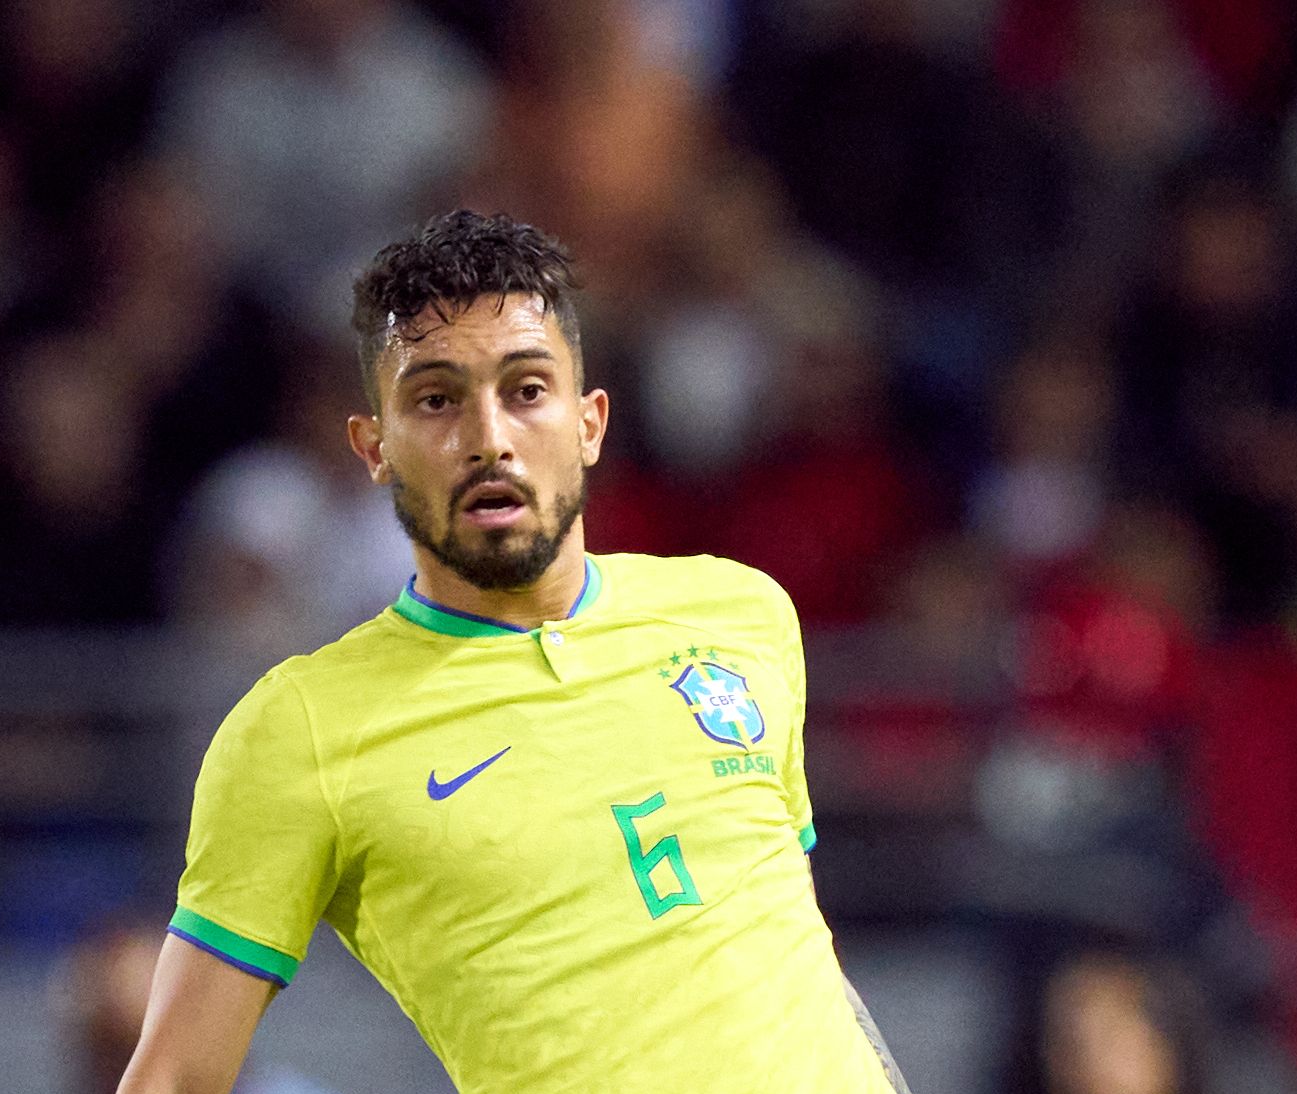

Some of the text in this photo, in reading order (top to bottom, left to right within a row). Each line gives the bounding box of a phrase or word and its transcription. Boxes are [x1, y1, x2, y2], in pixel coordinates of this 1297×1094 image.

[709, 694, 737, 707] CBF
[711, 755, 776, 777] BRASIL
[610, 791, 704, 920] 6
